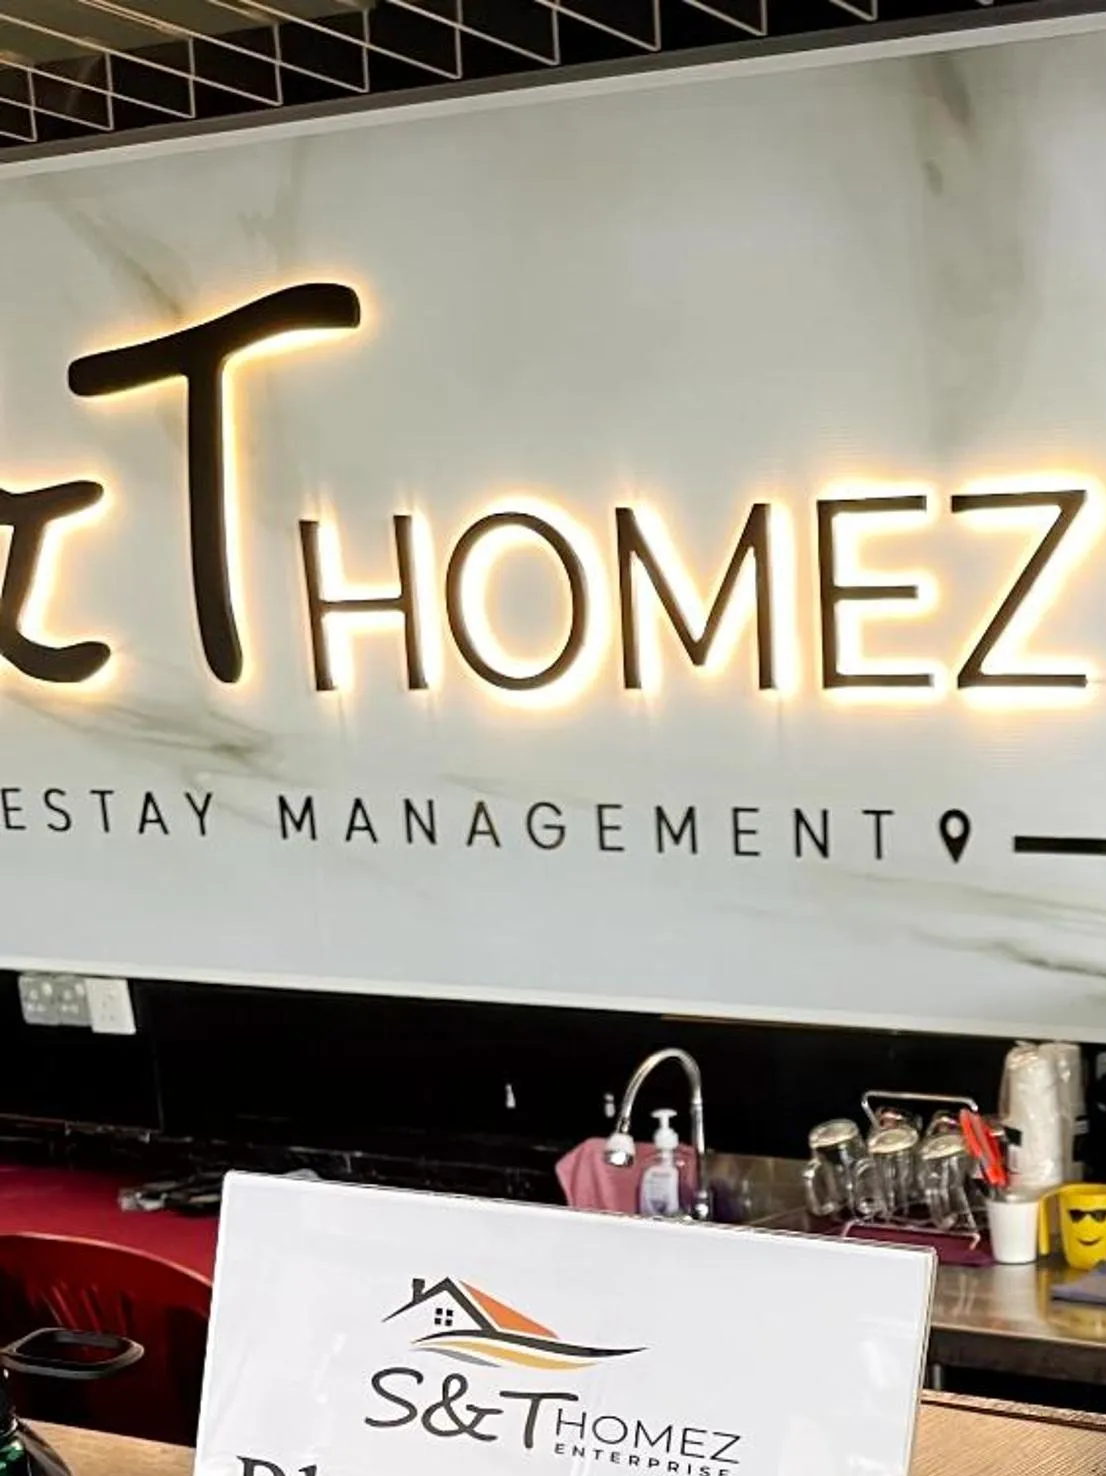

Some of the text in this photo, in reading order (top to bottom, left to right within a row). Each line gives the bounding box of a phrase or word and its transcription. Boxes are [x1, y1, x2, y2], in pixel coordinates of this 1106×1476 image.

[298, 488, 1089, 693] HOMEZ
[0, 787, 895, 861] ESTAY MANAGEMENT
